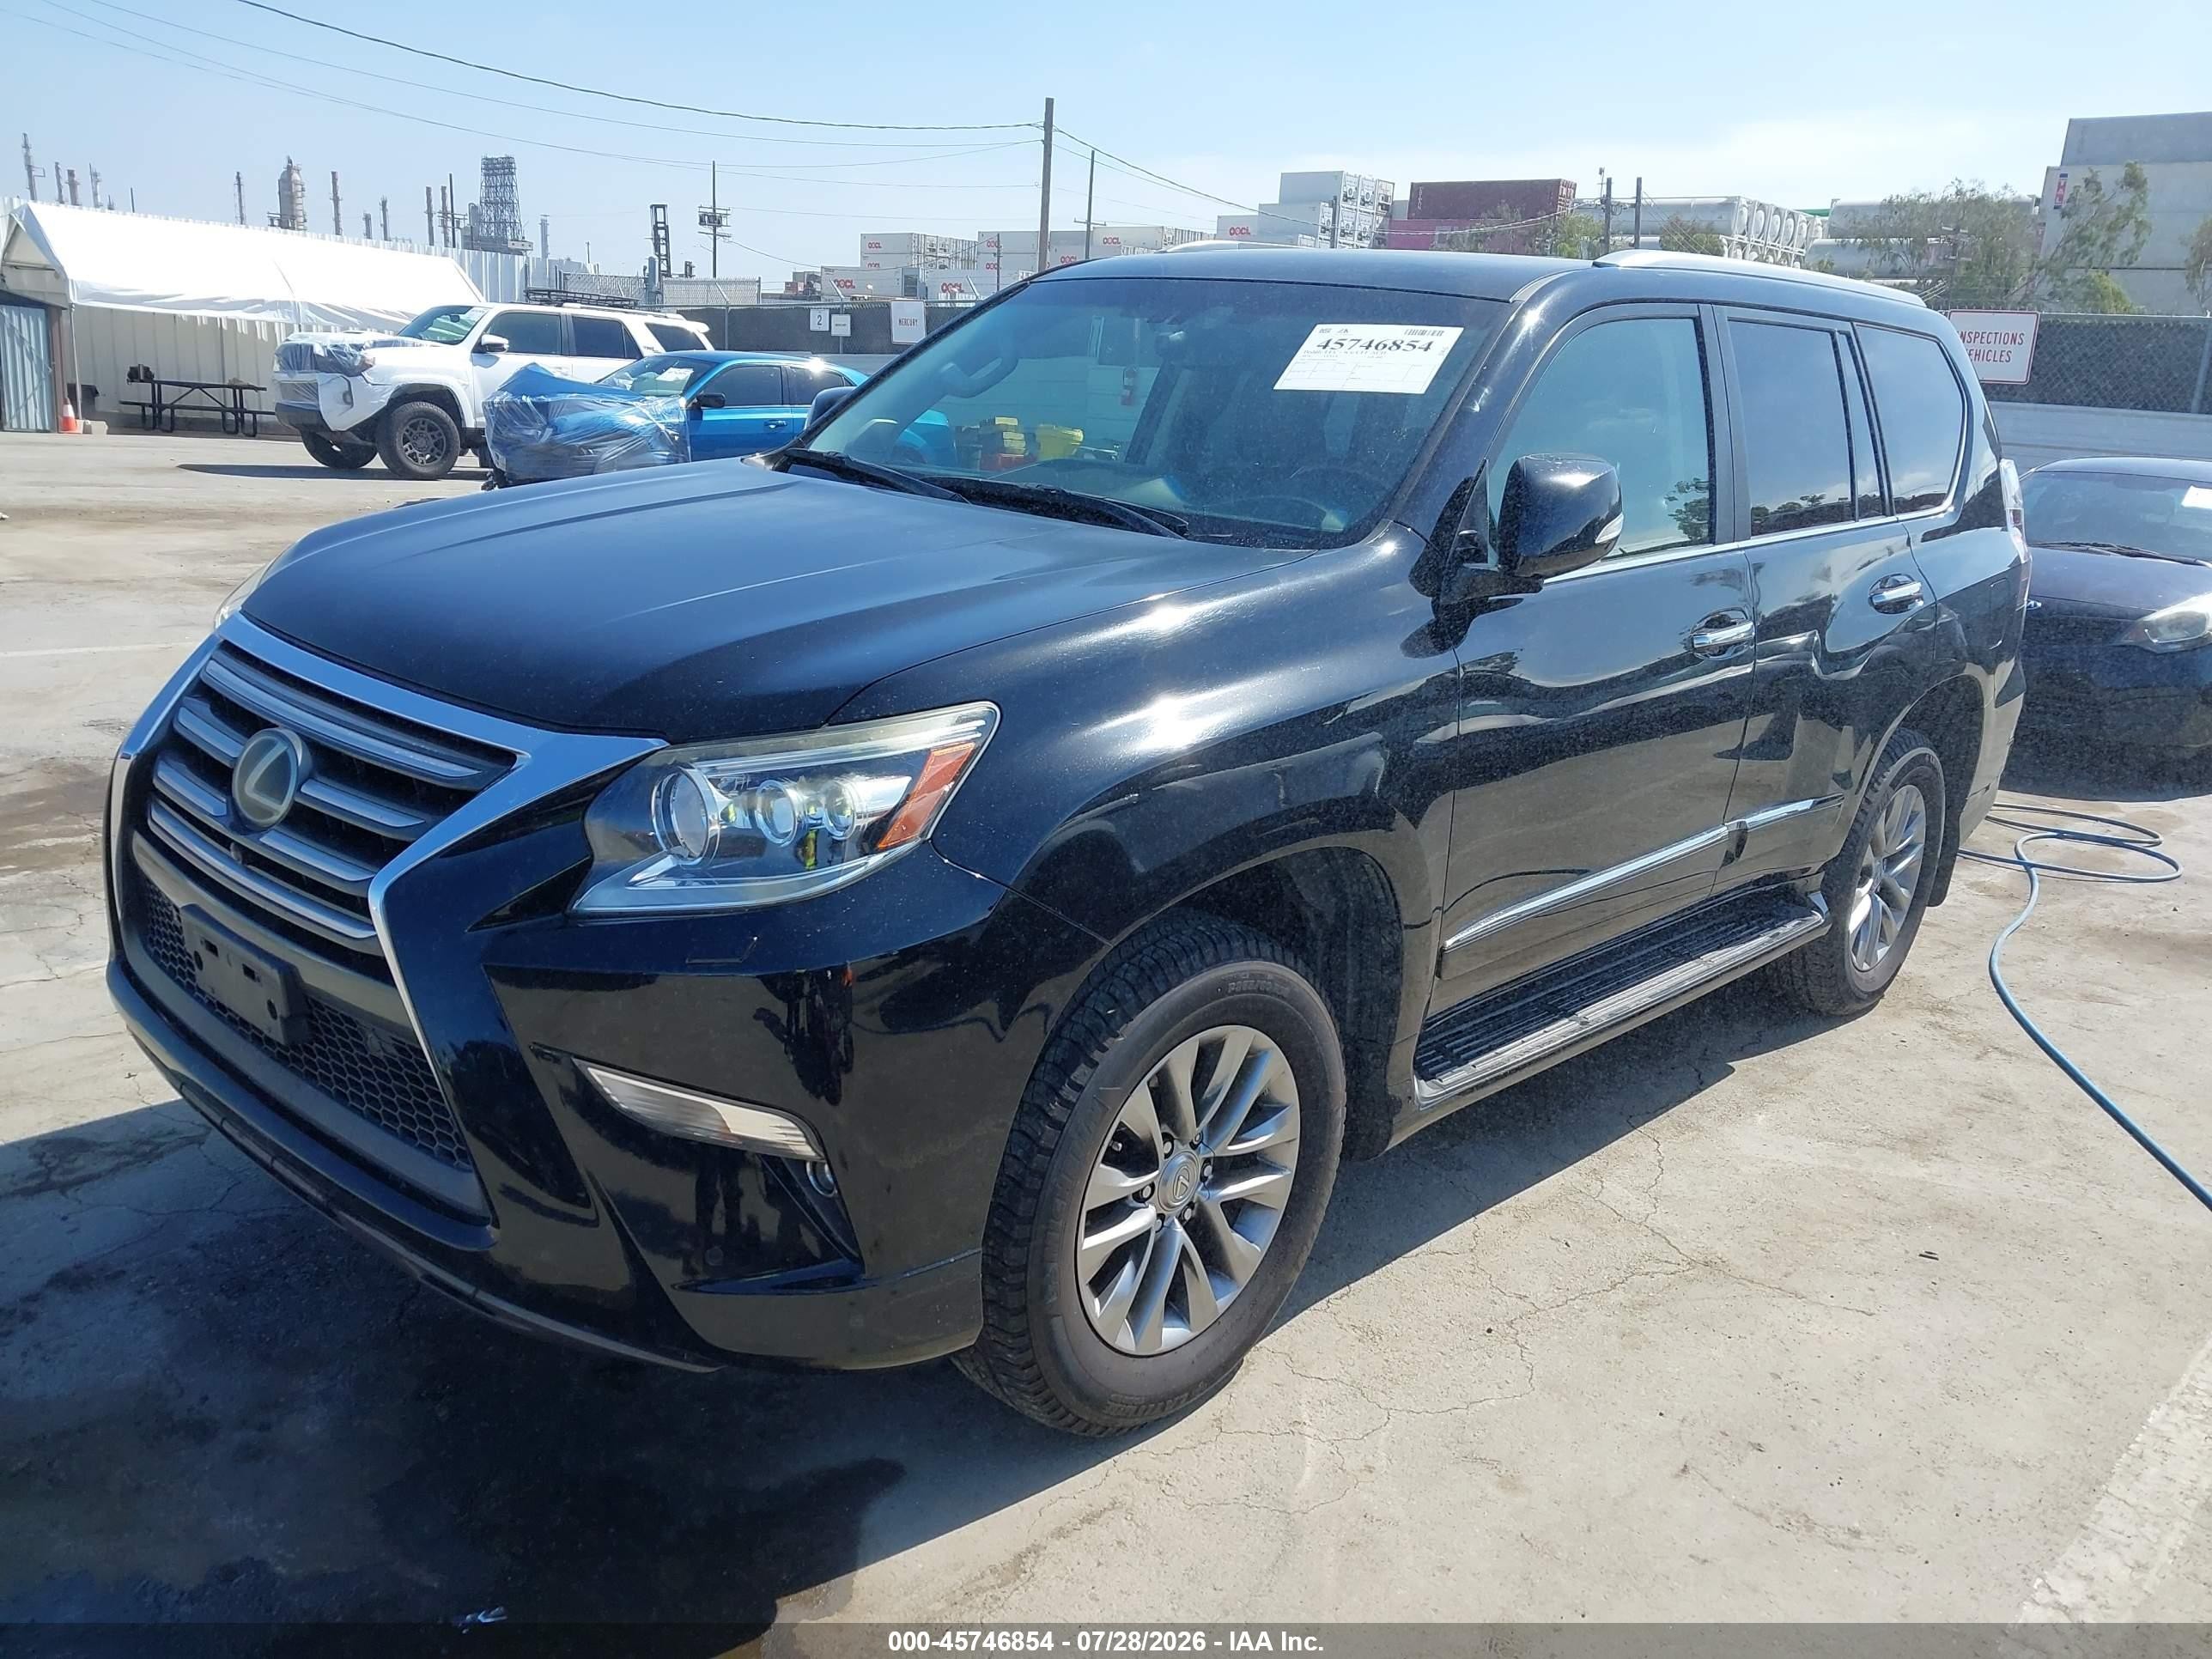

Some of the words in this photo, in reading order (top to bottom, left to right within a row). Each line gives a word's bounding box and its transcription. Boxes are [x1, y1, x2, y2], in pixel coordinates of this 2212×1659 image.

[1229, 226, 1250, 235] OOCL
[1103, 236, 1121, 245] OOCL
[817, 314, 822, 325] 2
[898, 318, 918, 326] MERCURY
[1957, 331, 2025, 345] NSPECTIONS
[1316, 337, 1435, 352] 45746854
[1966, 349, 2012, 362] EHICLES
